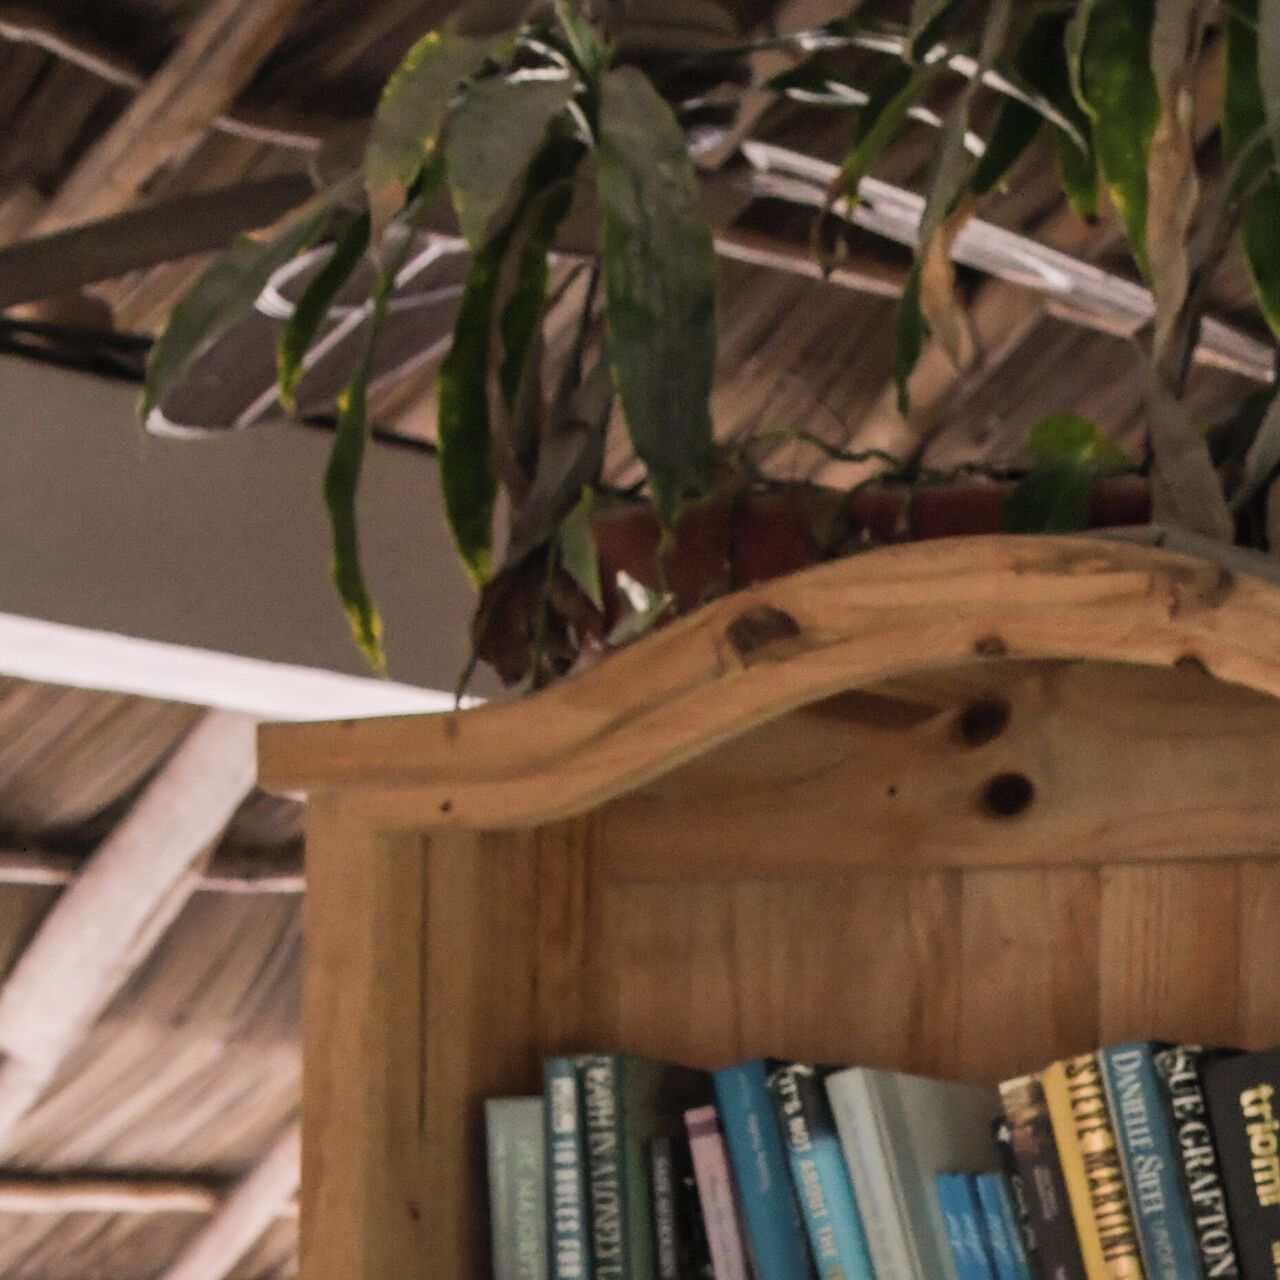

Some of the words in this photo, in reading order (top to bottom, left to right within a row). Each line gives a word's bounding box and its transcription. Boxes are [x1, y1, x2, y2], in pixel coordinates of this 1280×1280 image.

[1108, 1048, 1160, 1151] DANIELLE
[1156, 1047, 1206, 1119] SUE
[796, 1156, 830, 1220] ABOUT
[1080, 1143, 1140, 1264] MARTINI
[1130, 1150, 1172, 1215] STEEL
[1173, 1117, 1238, 1280] GRAFTON
[556, 1237, 582, 1278] FOR
